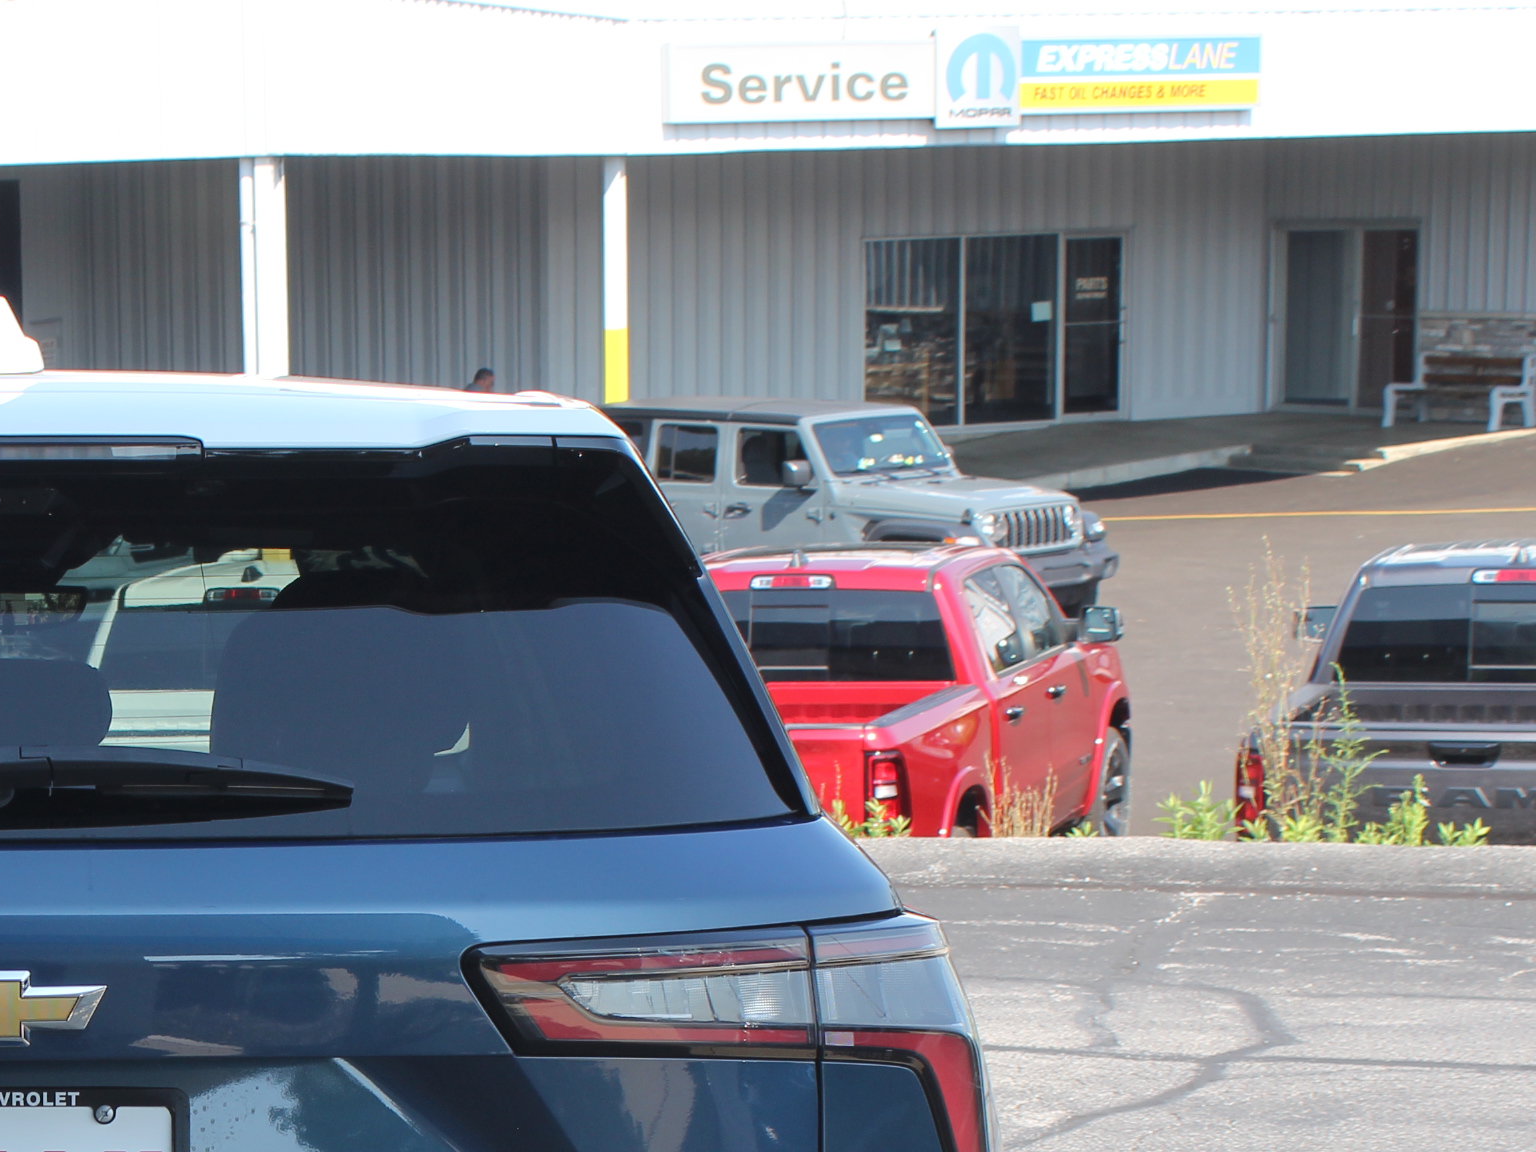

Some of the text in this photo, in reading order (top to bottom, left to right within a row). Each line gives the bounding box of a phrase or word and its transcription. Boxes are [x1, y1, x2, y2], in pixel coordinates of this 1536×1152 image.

[700, 61, 909, 104] Service
[1034, 83, 1207, 101] FAST OIL CHANGES & MORE
[948, 107, 1013, 119] MOPAR
